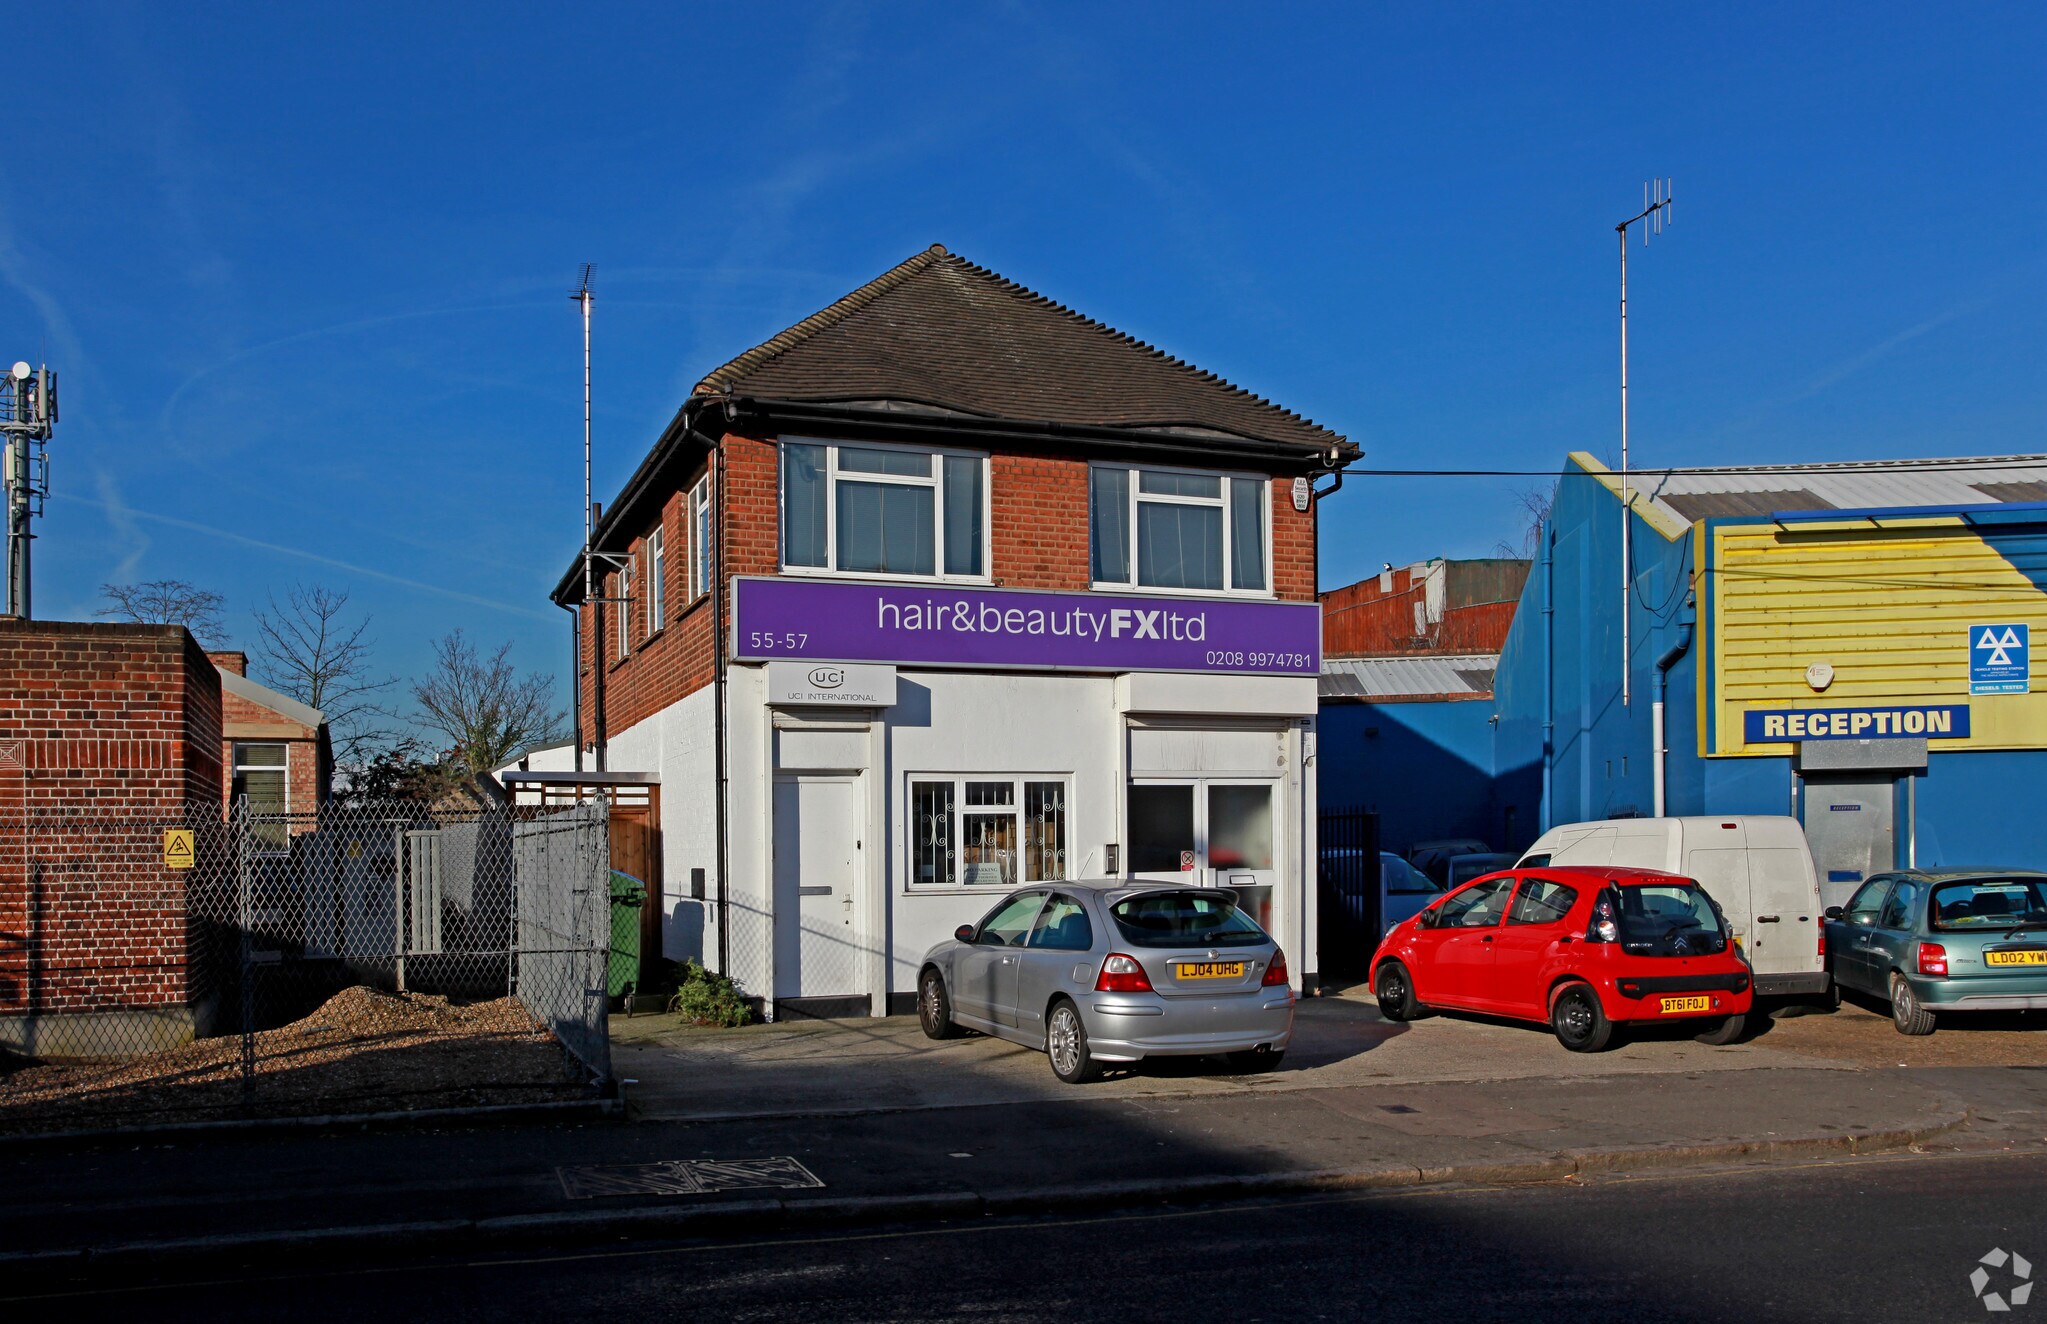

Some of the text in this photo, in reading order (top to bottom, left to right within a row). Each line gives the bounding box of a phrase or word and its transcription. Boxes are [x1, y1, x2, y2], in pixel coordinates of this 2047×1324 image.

[751, 632, 808, 649] 55-57
[1206, 651, 1311, 668] 0208 9974781
[787, 692, 877, 702] UCI INTERNATIONAL
[1764, 710, 1951, 737] RECEPTION
[1992, 952, 2047, 964] LD02 YW
[1181, 962, 1239, 977] LJ04 UHG
[1664, 998, 1704, 1011] BT61 FOJ
